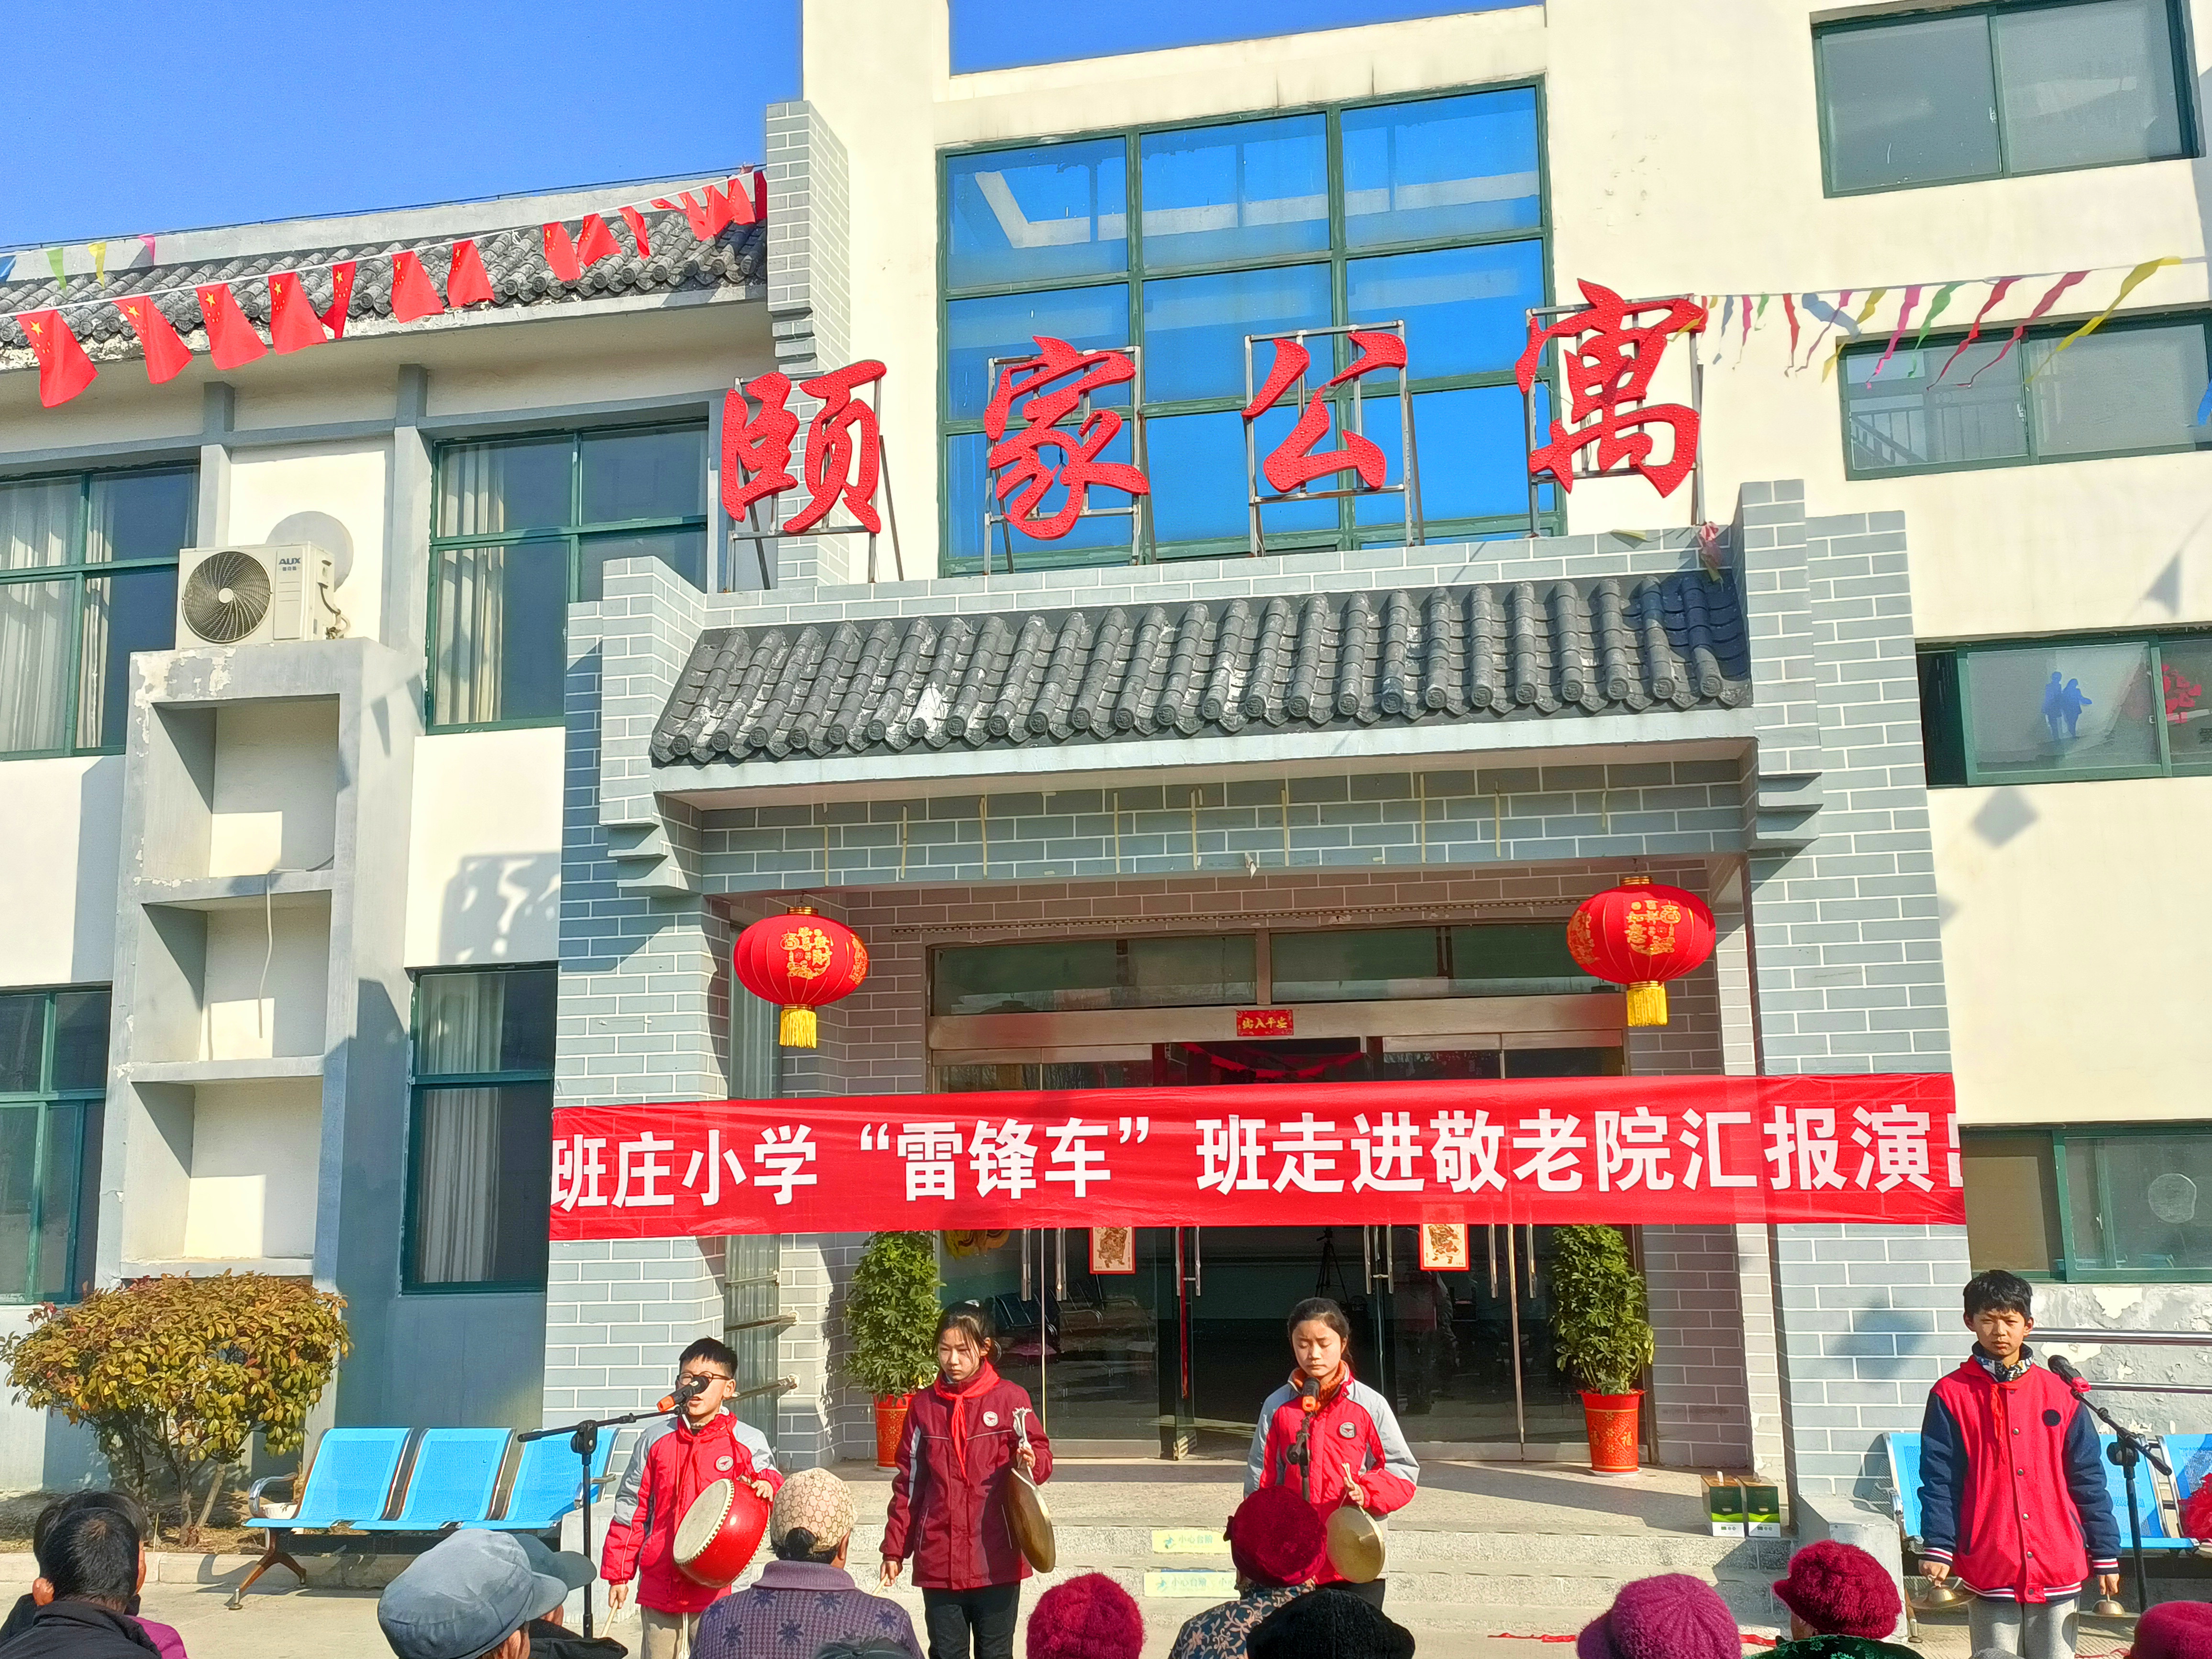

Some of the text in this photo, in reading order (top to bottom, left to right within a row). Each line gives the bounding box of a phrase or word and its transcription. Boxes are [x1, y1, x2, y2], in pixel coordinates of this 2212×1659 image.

[721, 279, 1704, 540] 颐家公寓
[551, 1104, 1963, 1212] 班庄小学“雷锋车”班走进敬老院汇报演
[1620, 1431, 1633, 1447] 福
